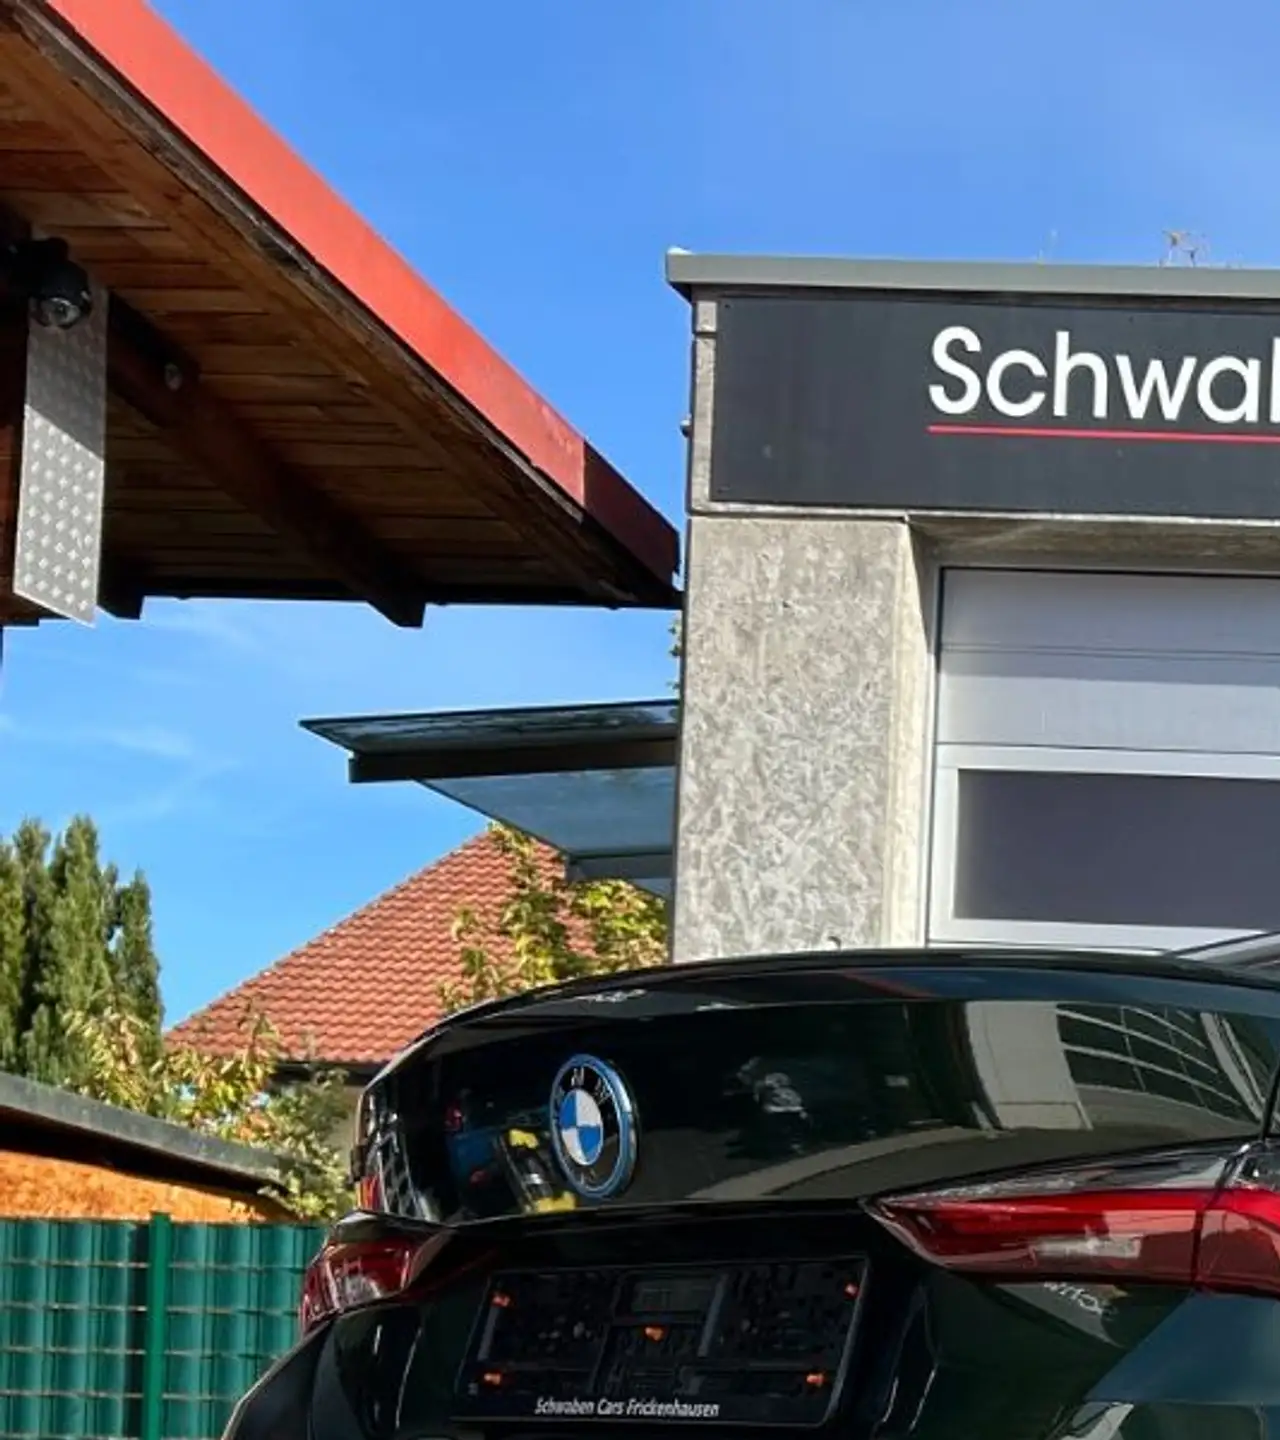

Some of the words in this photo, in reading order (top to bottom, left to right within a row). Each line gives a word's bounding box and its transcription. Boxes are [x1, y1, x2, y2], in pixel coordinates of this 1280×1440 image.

[534, 1396, 595, 1415] Schwaben
[597, 1398, 625, 1415] Cars
[626, 1397, 720, 1418] Frickenhausen
